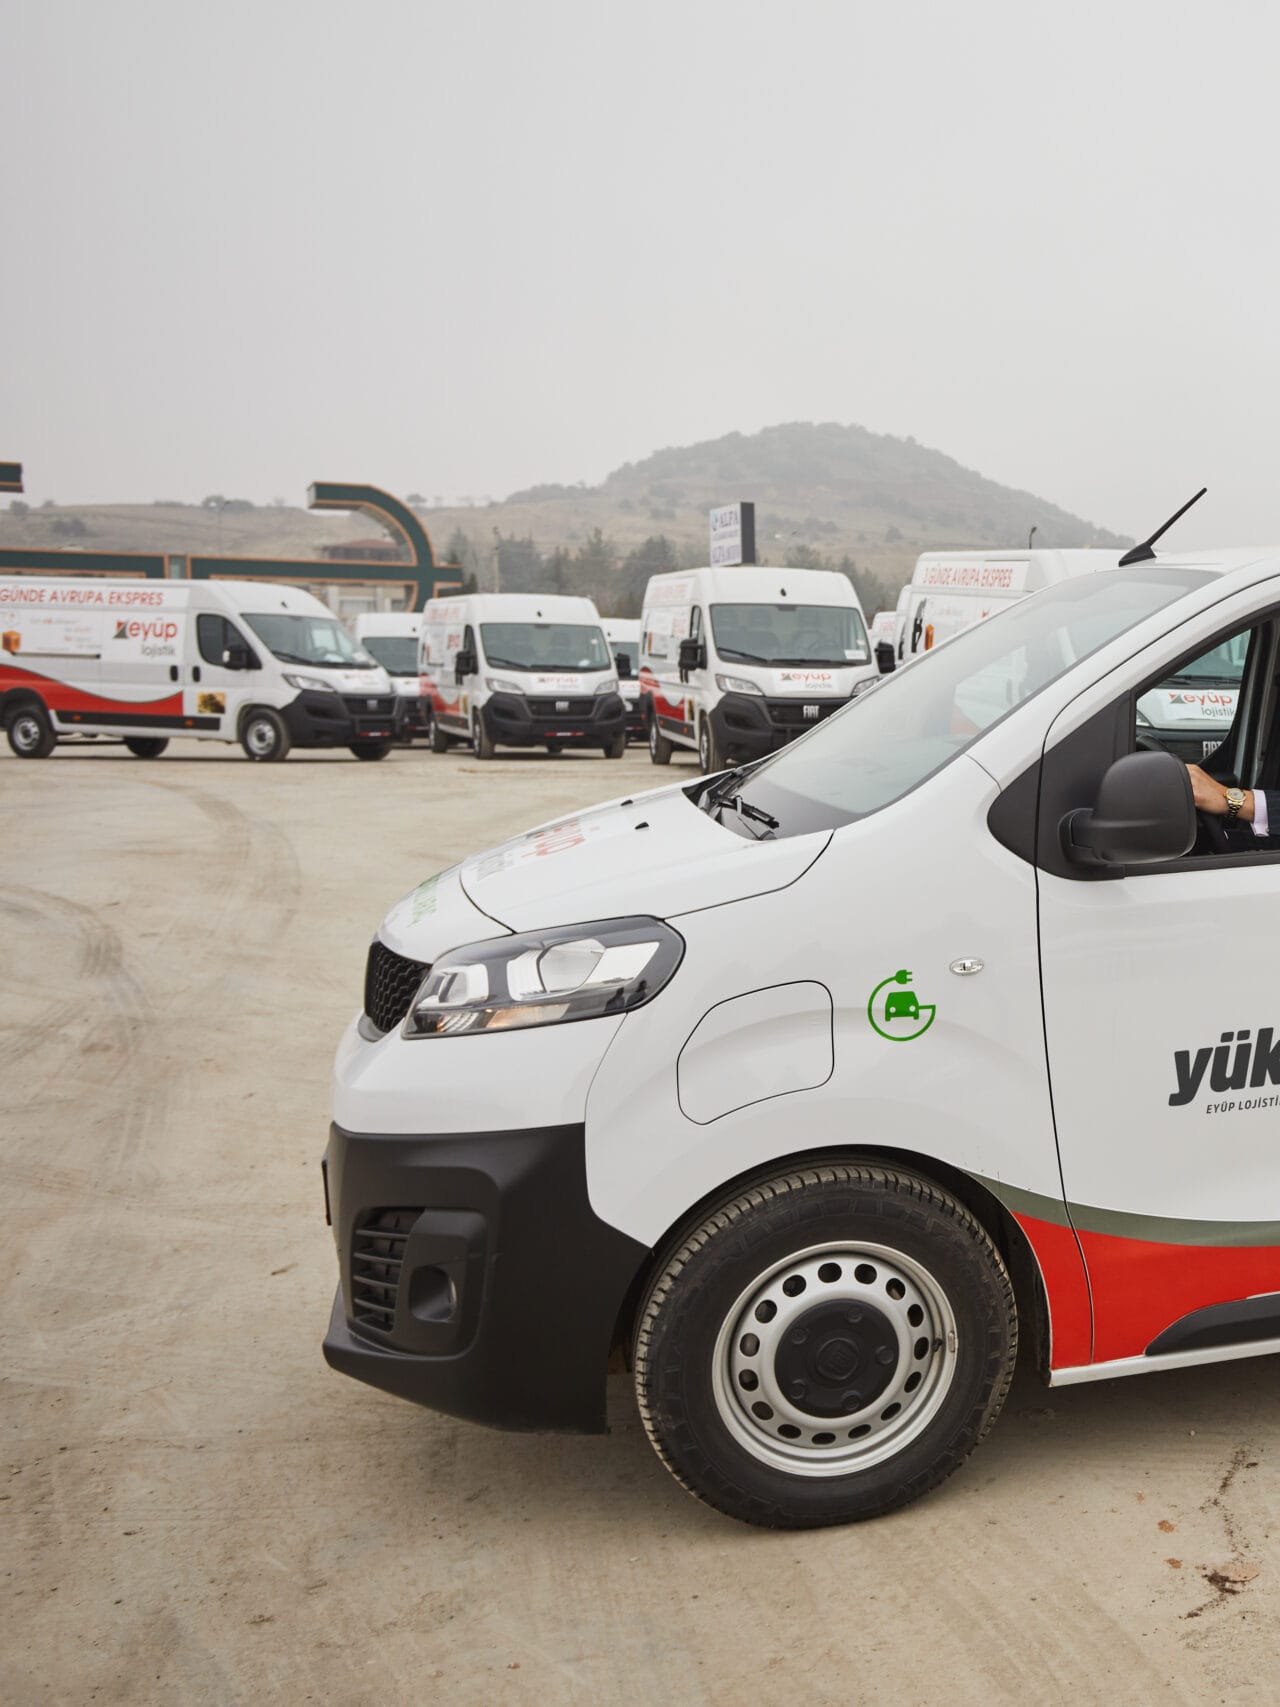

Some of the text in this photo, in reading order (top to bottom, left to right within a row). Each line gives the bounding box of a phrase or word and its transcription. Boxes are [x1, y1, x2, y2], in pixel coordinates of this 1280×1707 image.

[980, 568, 1013, 588] EKSPRES
[50, 589, 104, 605] AVRUPA
[108, 592, 163, 606] EKSPRES
[128, 617, 178, 641] eyüp
[1183, 691, 1232, 706] eyüp
[803, 705, 819, 719] FIAT
[1206, 1101, 1235, 1114] EYÜP
